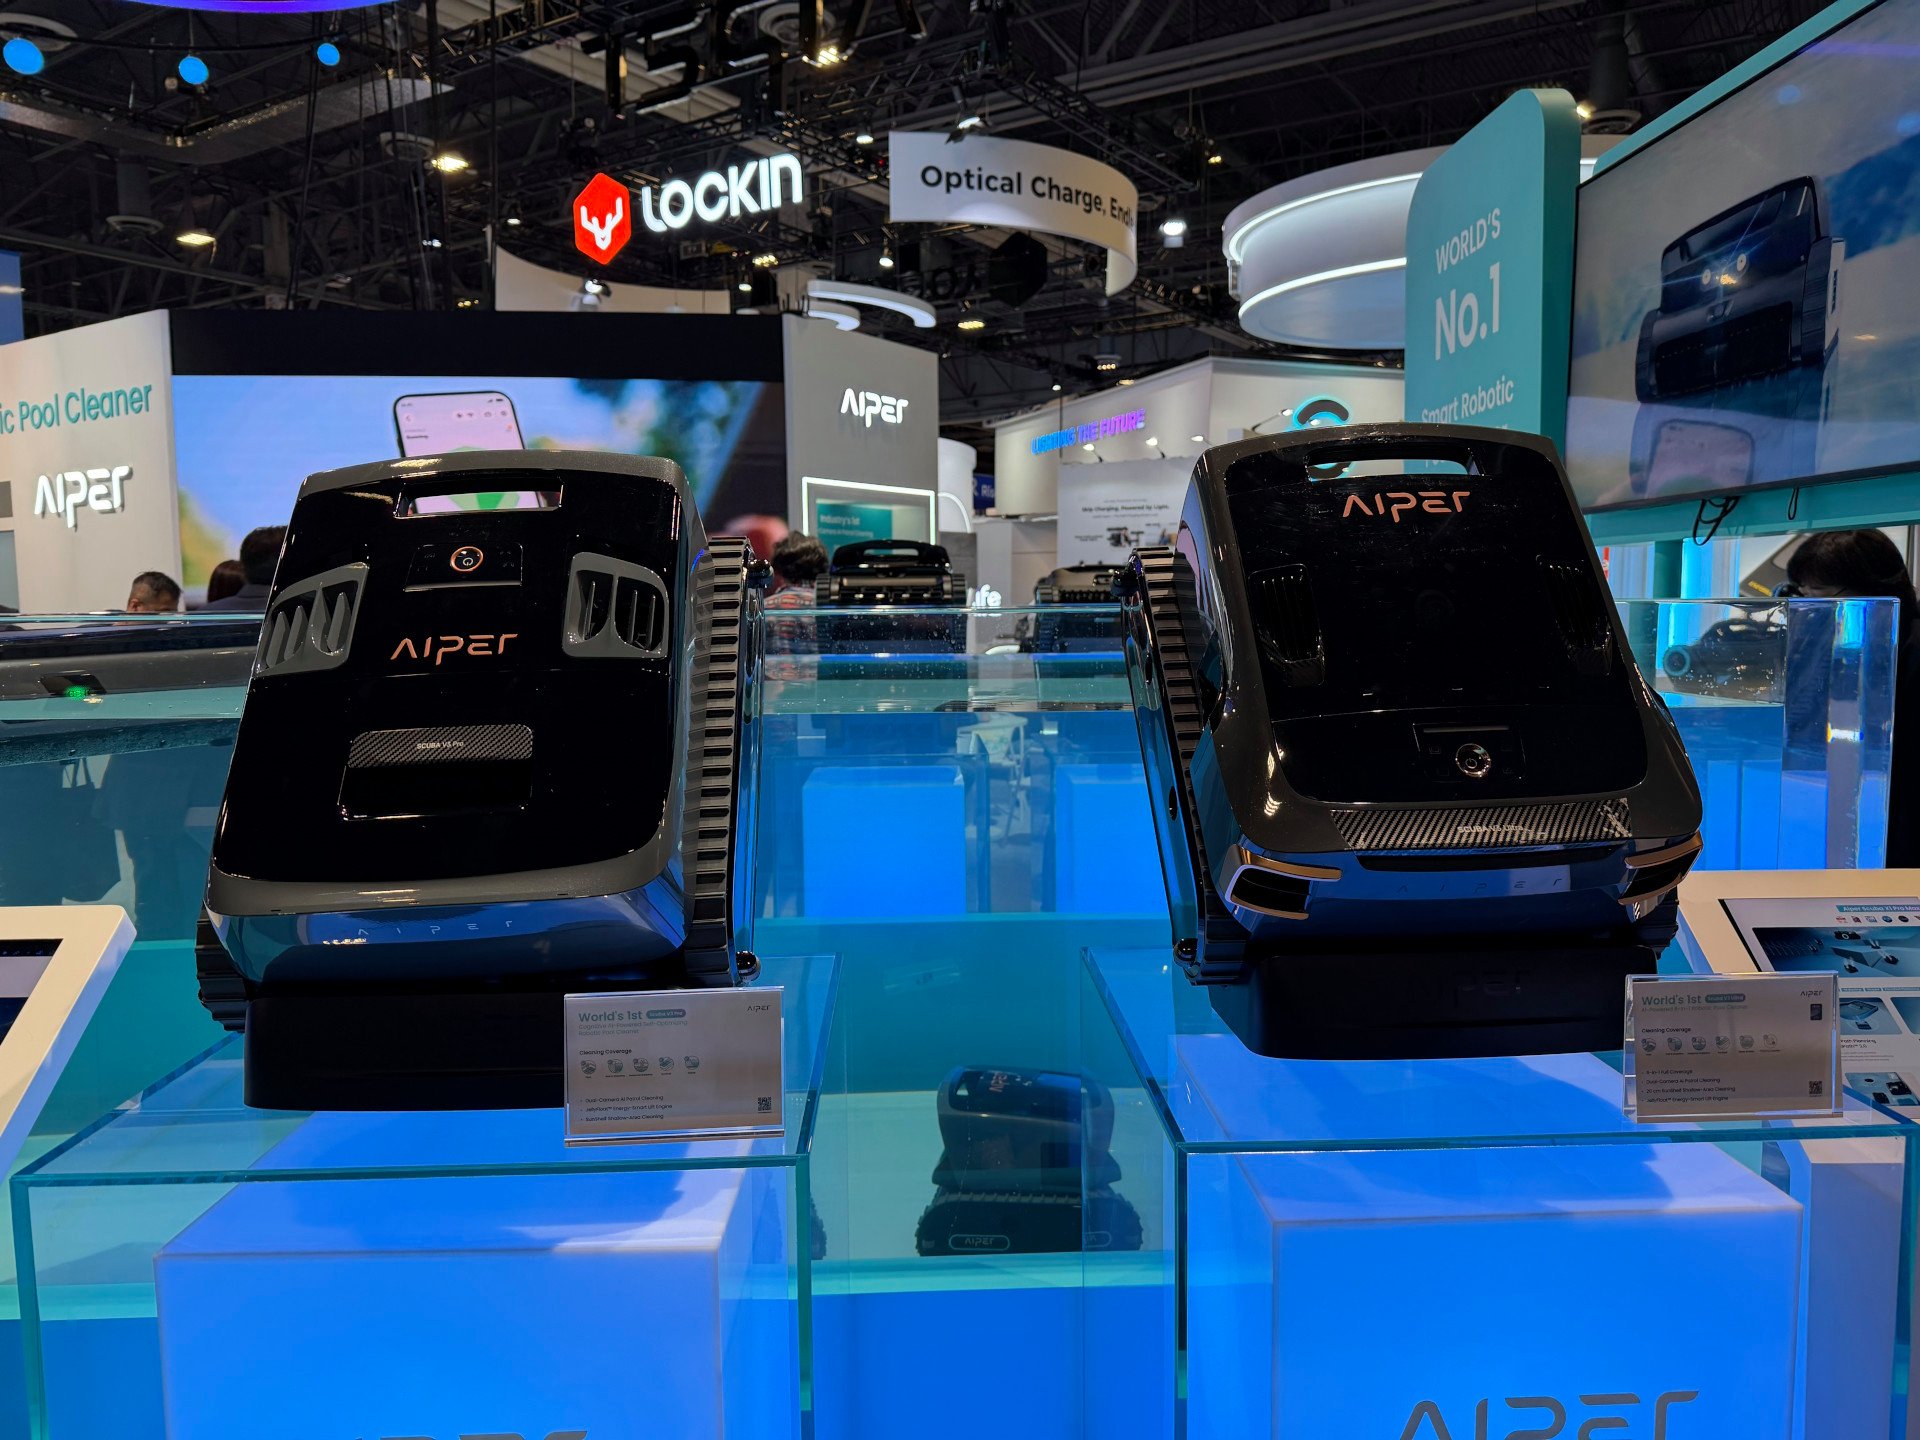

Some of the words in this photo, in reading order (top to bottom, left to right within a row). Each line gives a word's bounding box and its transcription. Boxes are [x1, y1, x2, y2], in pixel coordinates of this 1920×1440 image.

[641, 153, 803, 232] LOCKIN
[920, 165, 1022, 196] Optical
[1031, 176, 1106, 217] Charge,
[1435, 207, 1501, 275] WORLD'S
[1435, 262, 1500, 361] No.1
[19, 393, 60, 432] Pool
[65, 384, 152, 424] Cleaner
[1421, 397, 1458, 425] Smart
[1461, 375, 1514, 420] Robotic
[1077, 421, 1099, 444] THE
[1099, 408, 1146, 440] FUTURE
[416, 742, 441, 750] SCUBA
[1457, 825, 1488, 833] SCUBA
[578, 1010, 624, 1022] World's
[627, 1010, 643, 1021] 1st
[1642, 994, 1684, 1005] World's
[1687, 994, 1702, 1004] 1st
